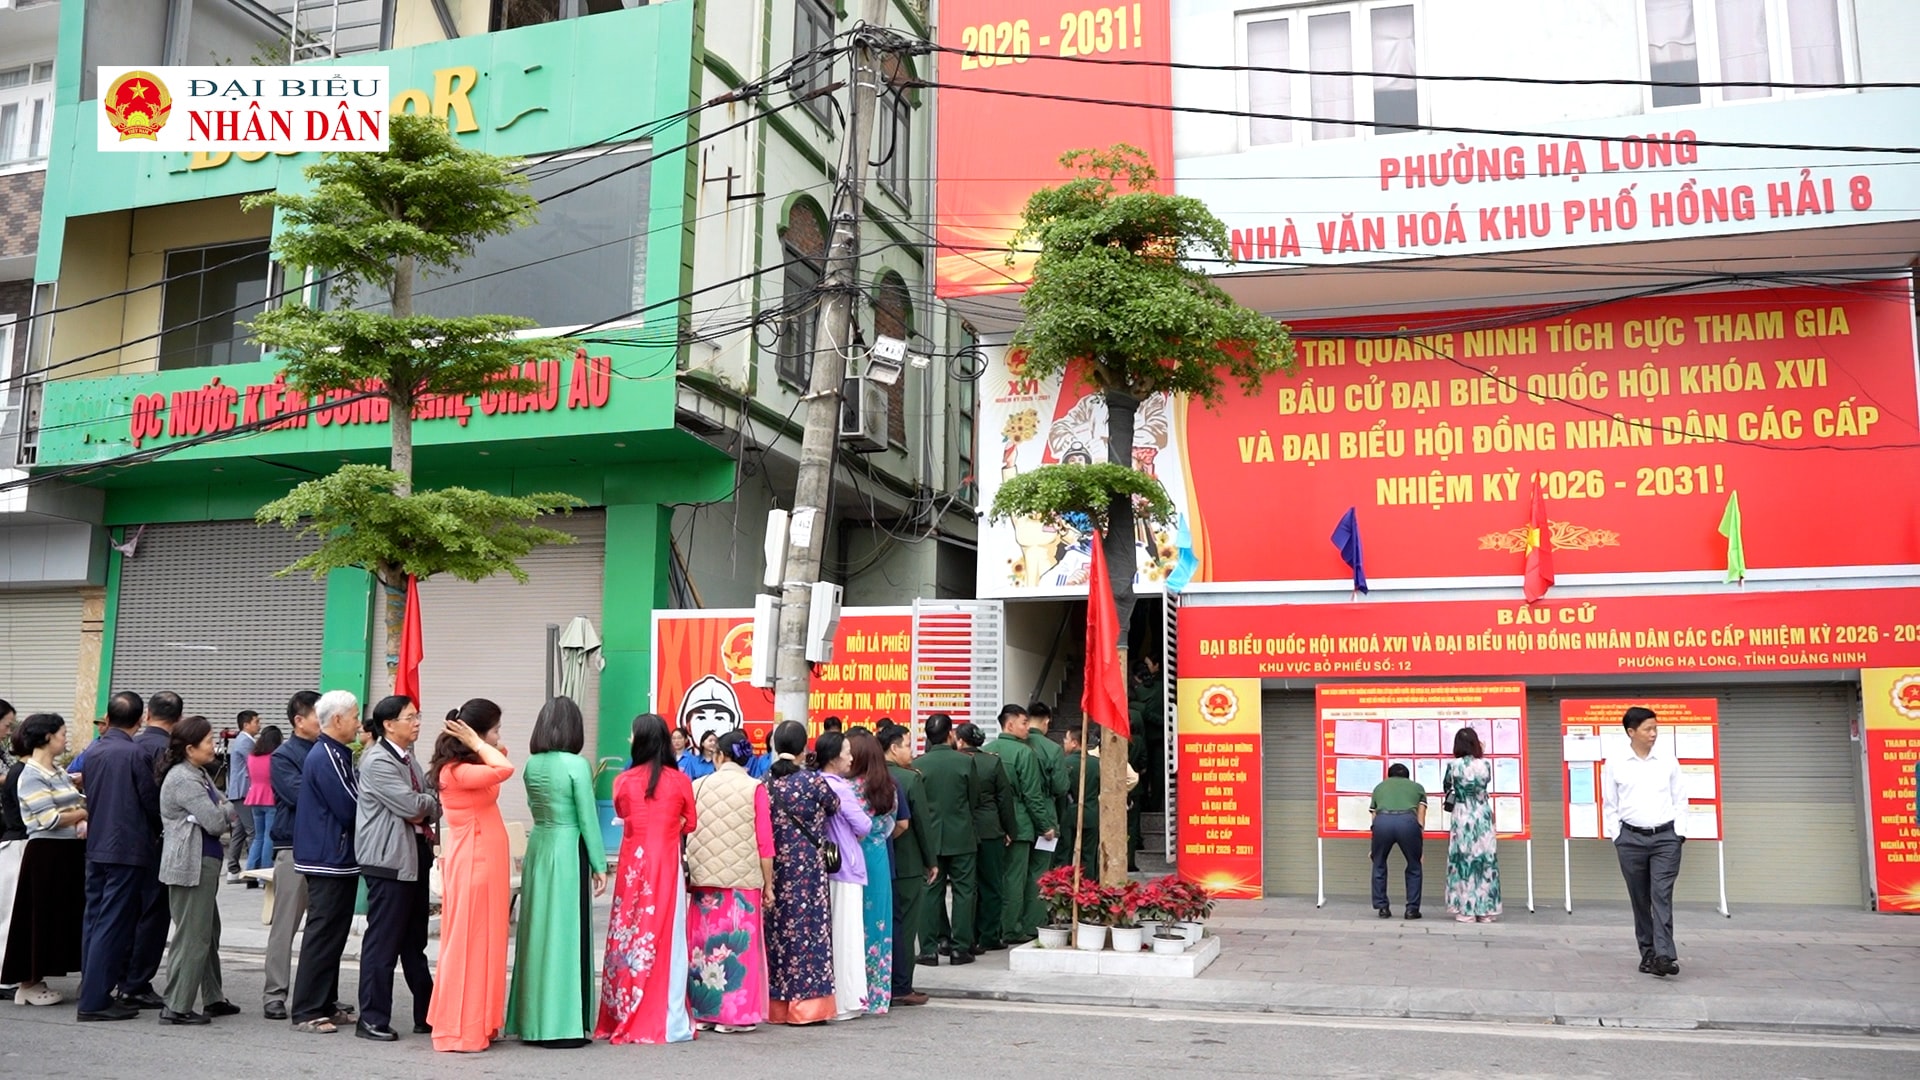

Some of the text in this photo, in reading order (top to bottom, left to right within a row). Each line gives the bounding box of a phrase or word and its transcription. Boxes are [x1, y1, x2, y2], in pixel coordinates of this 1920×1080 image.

[961, 3, 1142, 71] 2026 - 2031!
[1380, 130, 1698, 191] PHƯỜNG HẠ LONG
[1231, 168, 1873, 261] NHÀ VĂN HOÁ KHU PHỐ HỒNG HẢI 8
[1302, 338, 1346, 367] TRI
[1355, 326, 1454, 363] QUẢNG
[1463, 326, 1537, 358] NINH
[1545, 318, 1613, 353] TÍCH
[1623, 315, 1685, 353] CỰC
[1694, 310, 1785, 344] THAM
[1795, 306, 1850, 338] GIA
[168, 377, 238, 437] NƯỚC
[568, 348, 612, 409] ÂU
[1279, 357, 1828, 415] BẦU CỬ ĐẠI BIỂU QUỐC HỘI KHÓA XVI
[1238, 396, 1879, 467] VÀ ĐẠI BIỂU HỘI ĐỒNG NHÂN DÂN CÁC CẤP
[1376, 470, 1473, 511] NHIỆM
[1483, 467, 1521, 501] KỲ
[1530, 469, 1605, 499] 2026
[1636, 464, 1725, 496] 2031!
[1497, 602, 1597, 625] BẦU CỬ
[867, 632, 880, 652] LÁ
[881, 630, 911, 652] PHIẾU
[1200, 639, 1225, 658] ĐẠI
[1228, 632, 1262, 655] BIỂU
[1266, 632, 1306, 656] QUỐC
[1309, 634, 1335, 657] HỘI
[1383, 636, 1407, 653] XVI
[1412, 632, 1432, 652] VÀ
[1435, 635, 1462, 654] ĐẠI
[1466, 628, 1502, 650] BIỂU
[1506, 630, 1533, 654] HỘI
[1585, 628, 1631, 650] NHÂN
[1636, 627, 1669, 648] DÂN
[1673, 626, 1707, 648] CÁC
[1711, 624, 1745, 647] CẤP
[1749, 625, 1806, 648] NHIỆM
[1810, 624, 1832, 644] KỲ
[1836, 625, 1879, 643] 2026
[1618, 651, 1867, 668] PHƯỜNG HẠ LONG, TỈNH QUẢNG NINH
[857, 664, 873, 681] TRI
[875, 658, 909, 683] QUẢNG
[1259, 662, 1284, 673] KHU
[1286, 661, 1311, 674] VỰC
[1314, 659, 1331, 672] BỎ
[1334, 658, 1371, 672] PHIẾU
[1398, 661, 1412, 671] 12
[876, 689, 897, 714] MỘT
